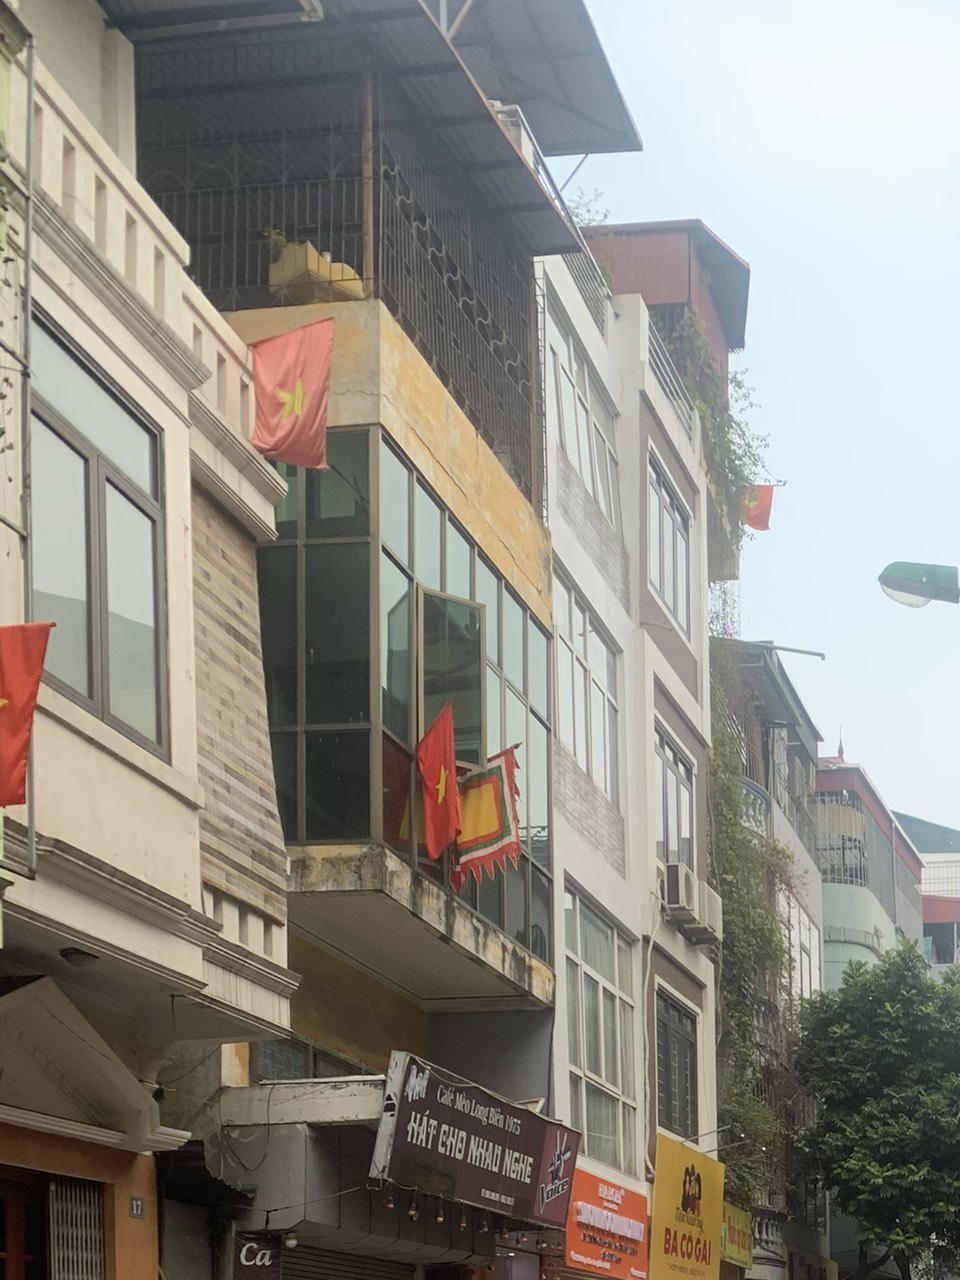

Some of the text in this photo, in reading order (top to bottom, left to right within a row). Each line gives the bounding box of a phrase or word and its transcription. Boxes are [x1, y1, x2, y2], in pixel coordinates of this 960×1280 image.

[437, 1084, 455, 1107] Café
[470, 1101, 488, 1126] Long
[506, 1114, 522, 1135] 1975
[407, 1110, 534, 1184] HÁT CHO NHAU NGHE
[539, 1178, 569, 1214] Voice
[239, 1242, 273, 1266] Ca
[663, 1227, 678, 1257] BA
[680, 1230, 693, 1260] CÔ
